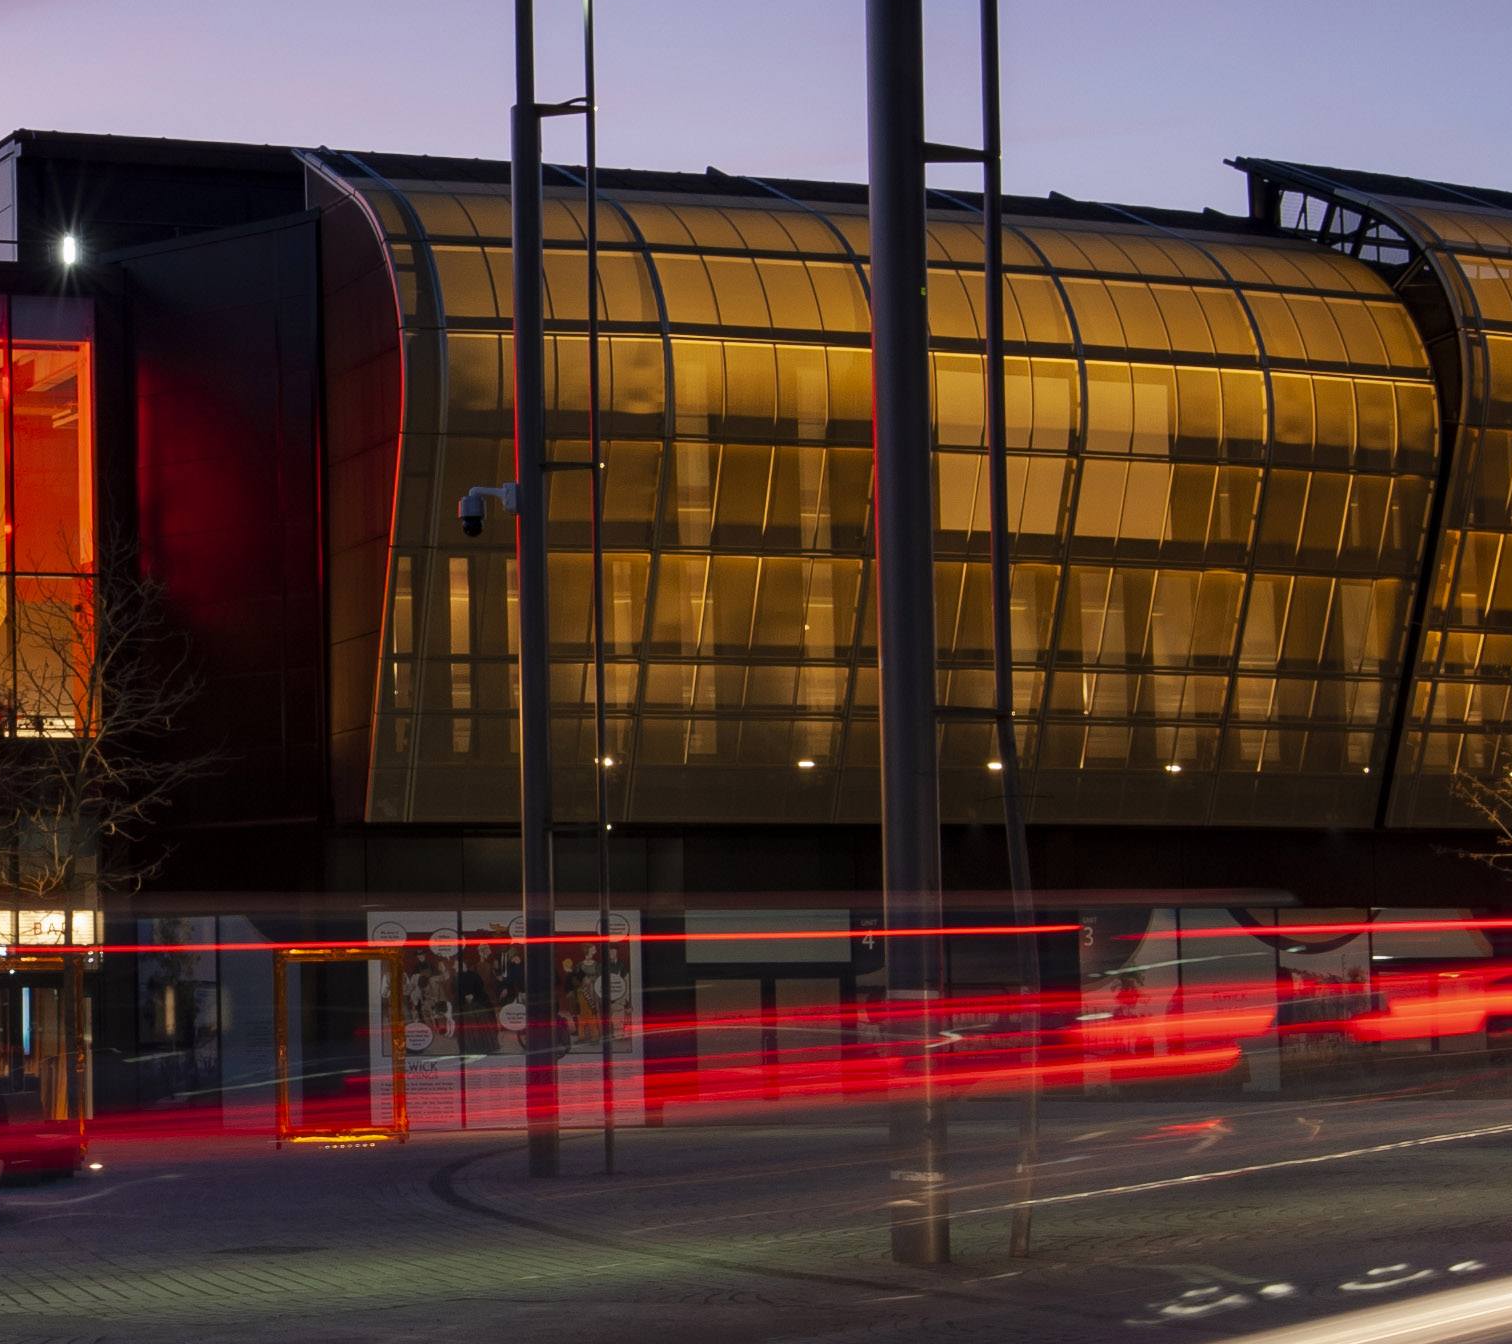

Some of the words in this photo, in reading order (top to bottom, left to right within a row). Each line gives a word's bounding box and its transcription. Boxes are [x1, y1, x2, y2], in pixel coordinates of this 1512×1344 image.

[862, 930, 875, 950] 4
[1084, 926, 1094, 946] 3
[408, 1061, 438, 1072] WICK
